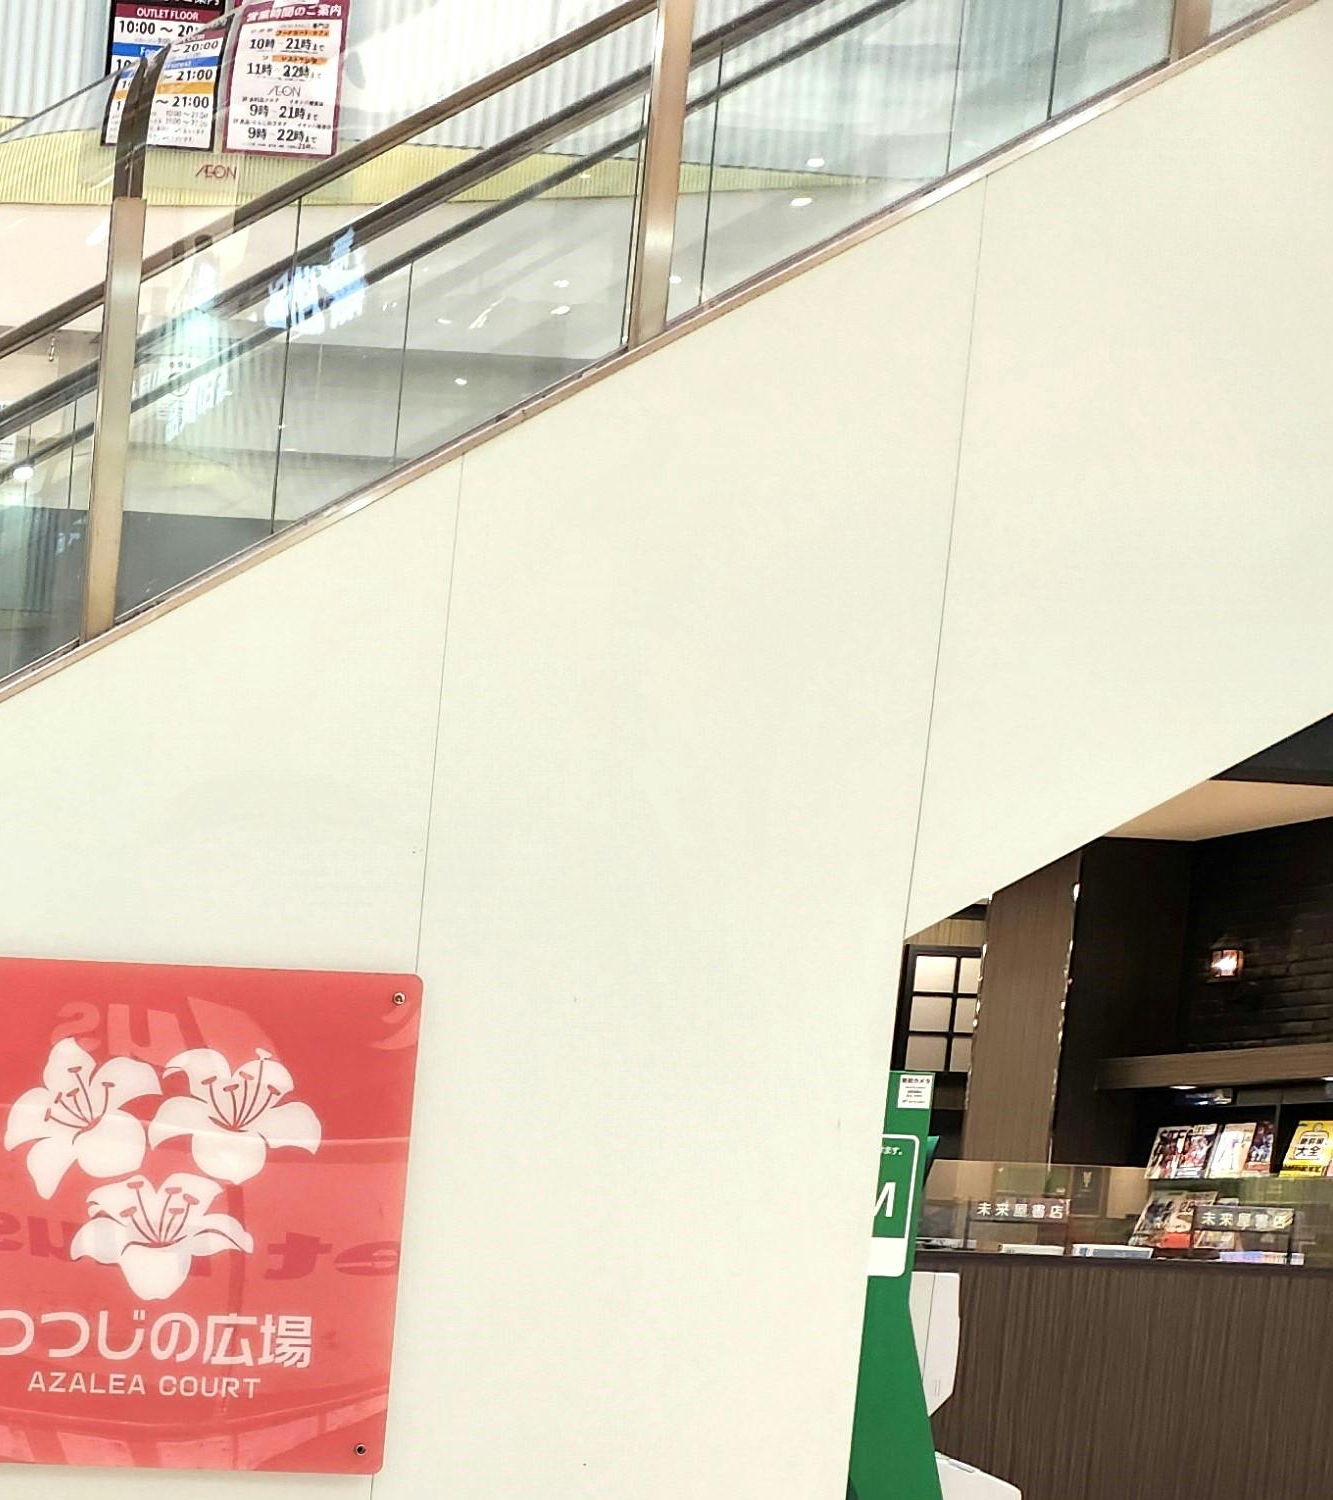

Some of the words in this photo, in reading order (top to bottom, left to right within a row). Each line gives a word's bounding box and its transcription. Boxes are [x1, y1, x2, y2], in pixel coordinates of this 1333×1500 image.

[136, 7, 169, 19] OUTLET
[170, 11, 198, 21] FLOOR
[119, 20, 155, 34] 10:00
[173, 96, 209, 108] 21:00
[976, 1201, 1065, 1219] 未来屋書店
[28, 1371, 146, 1395] AZALEA
[158, 1375, 262, 1399] COURT
